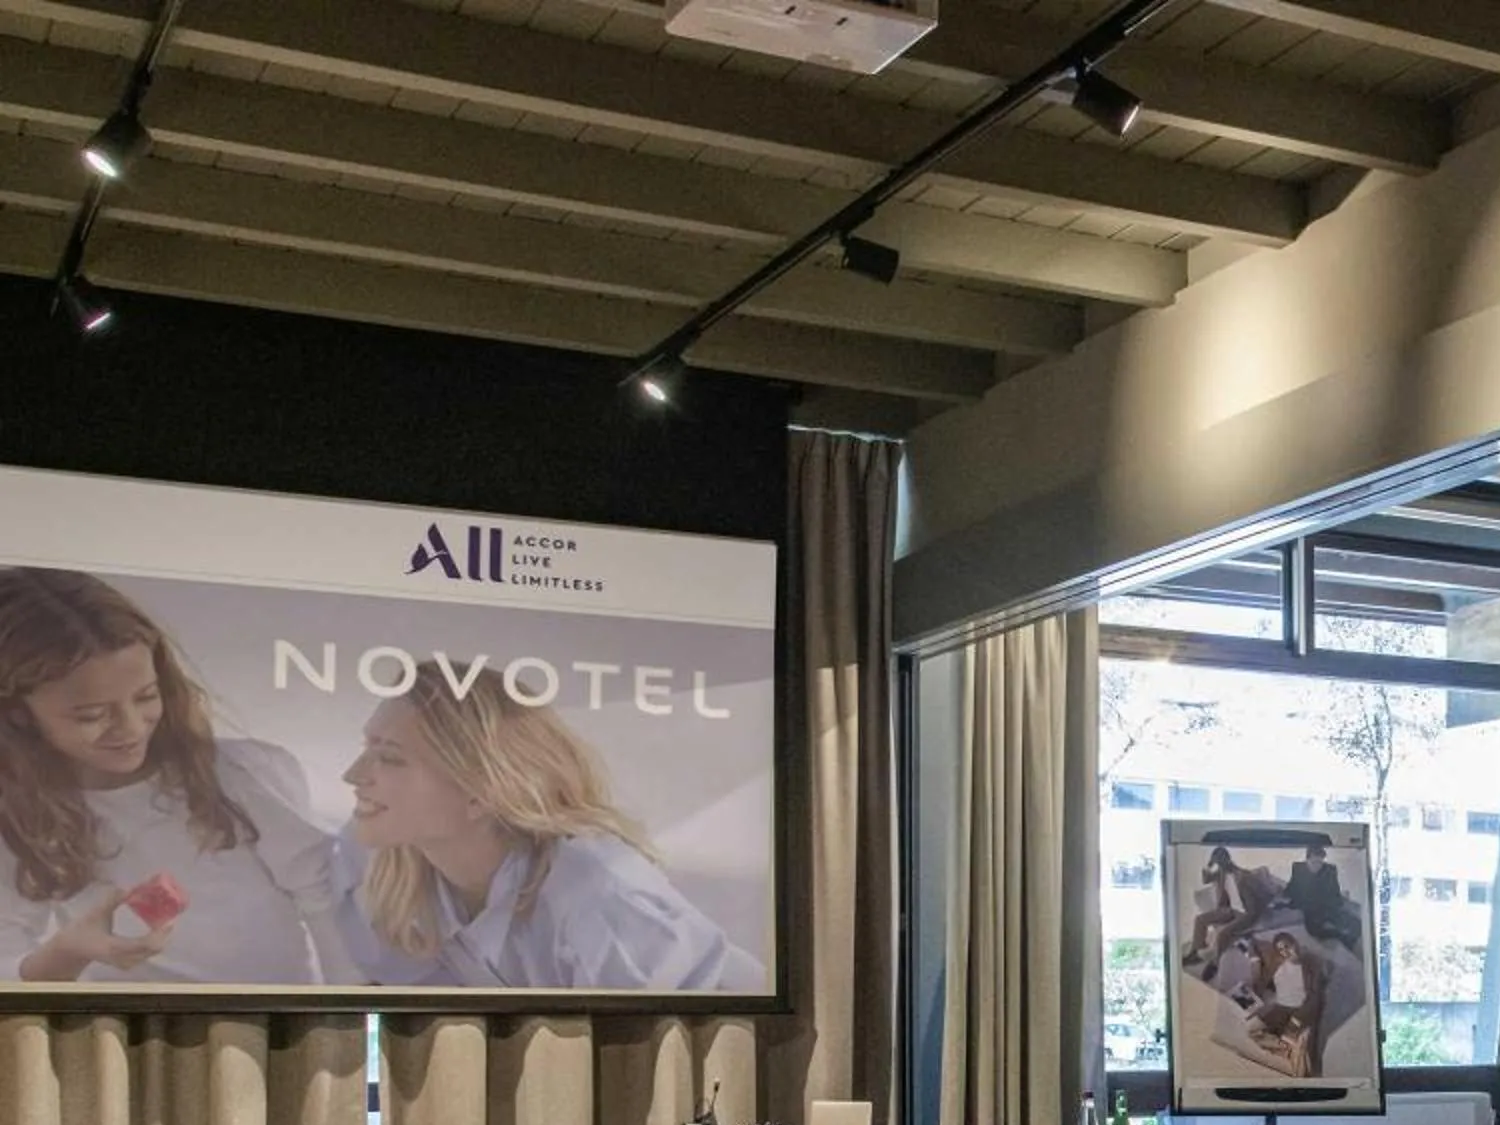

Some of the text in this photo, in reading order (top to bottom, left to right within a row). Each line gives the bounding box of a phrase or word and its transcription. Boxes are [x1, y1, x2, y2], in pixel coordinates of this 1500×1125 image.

[513, 535, 578, 551] ACCOR
[512, 554, 552, 568] LIVE
[511, 574, 604, 592] LIMITLESS
[273, 639, 732, 720] NOVOTEL
